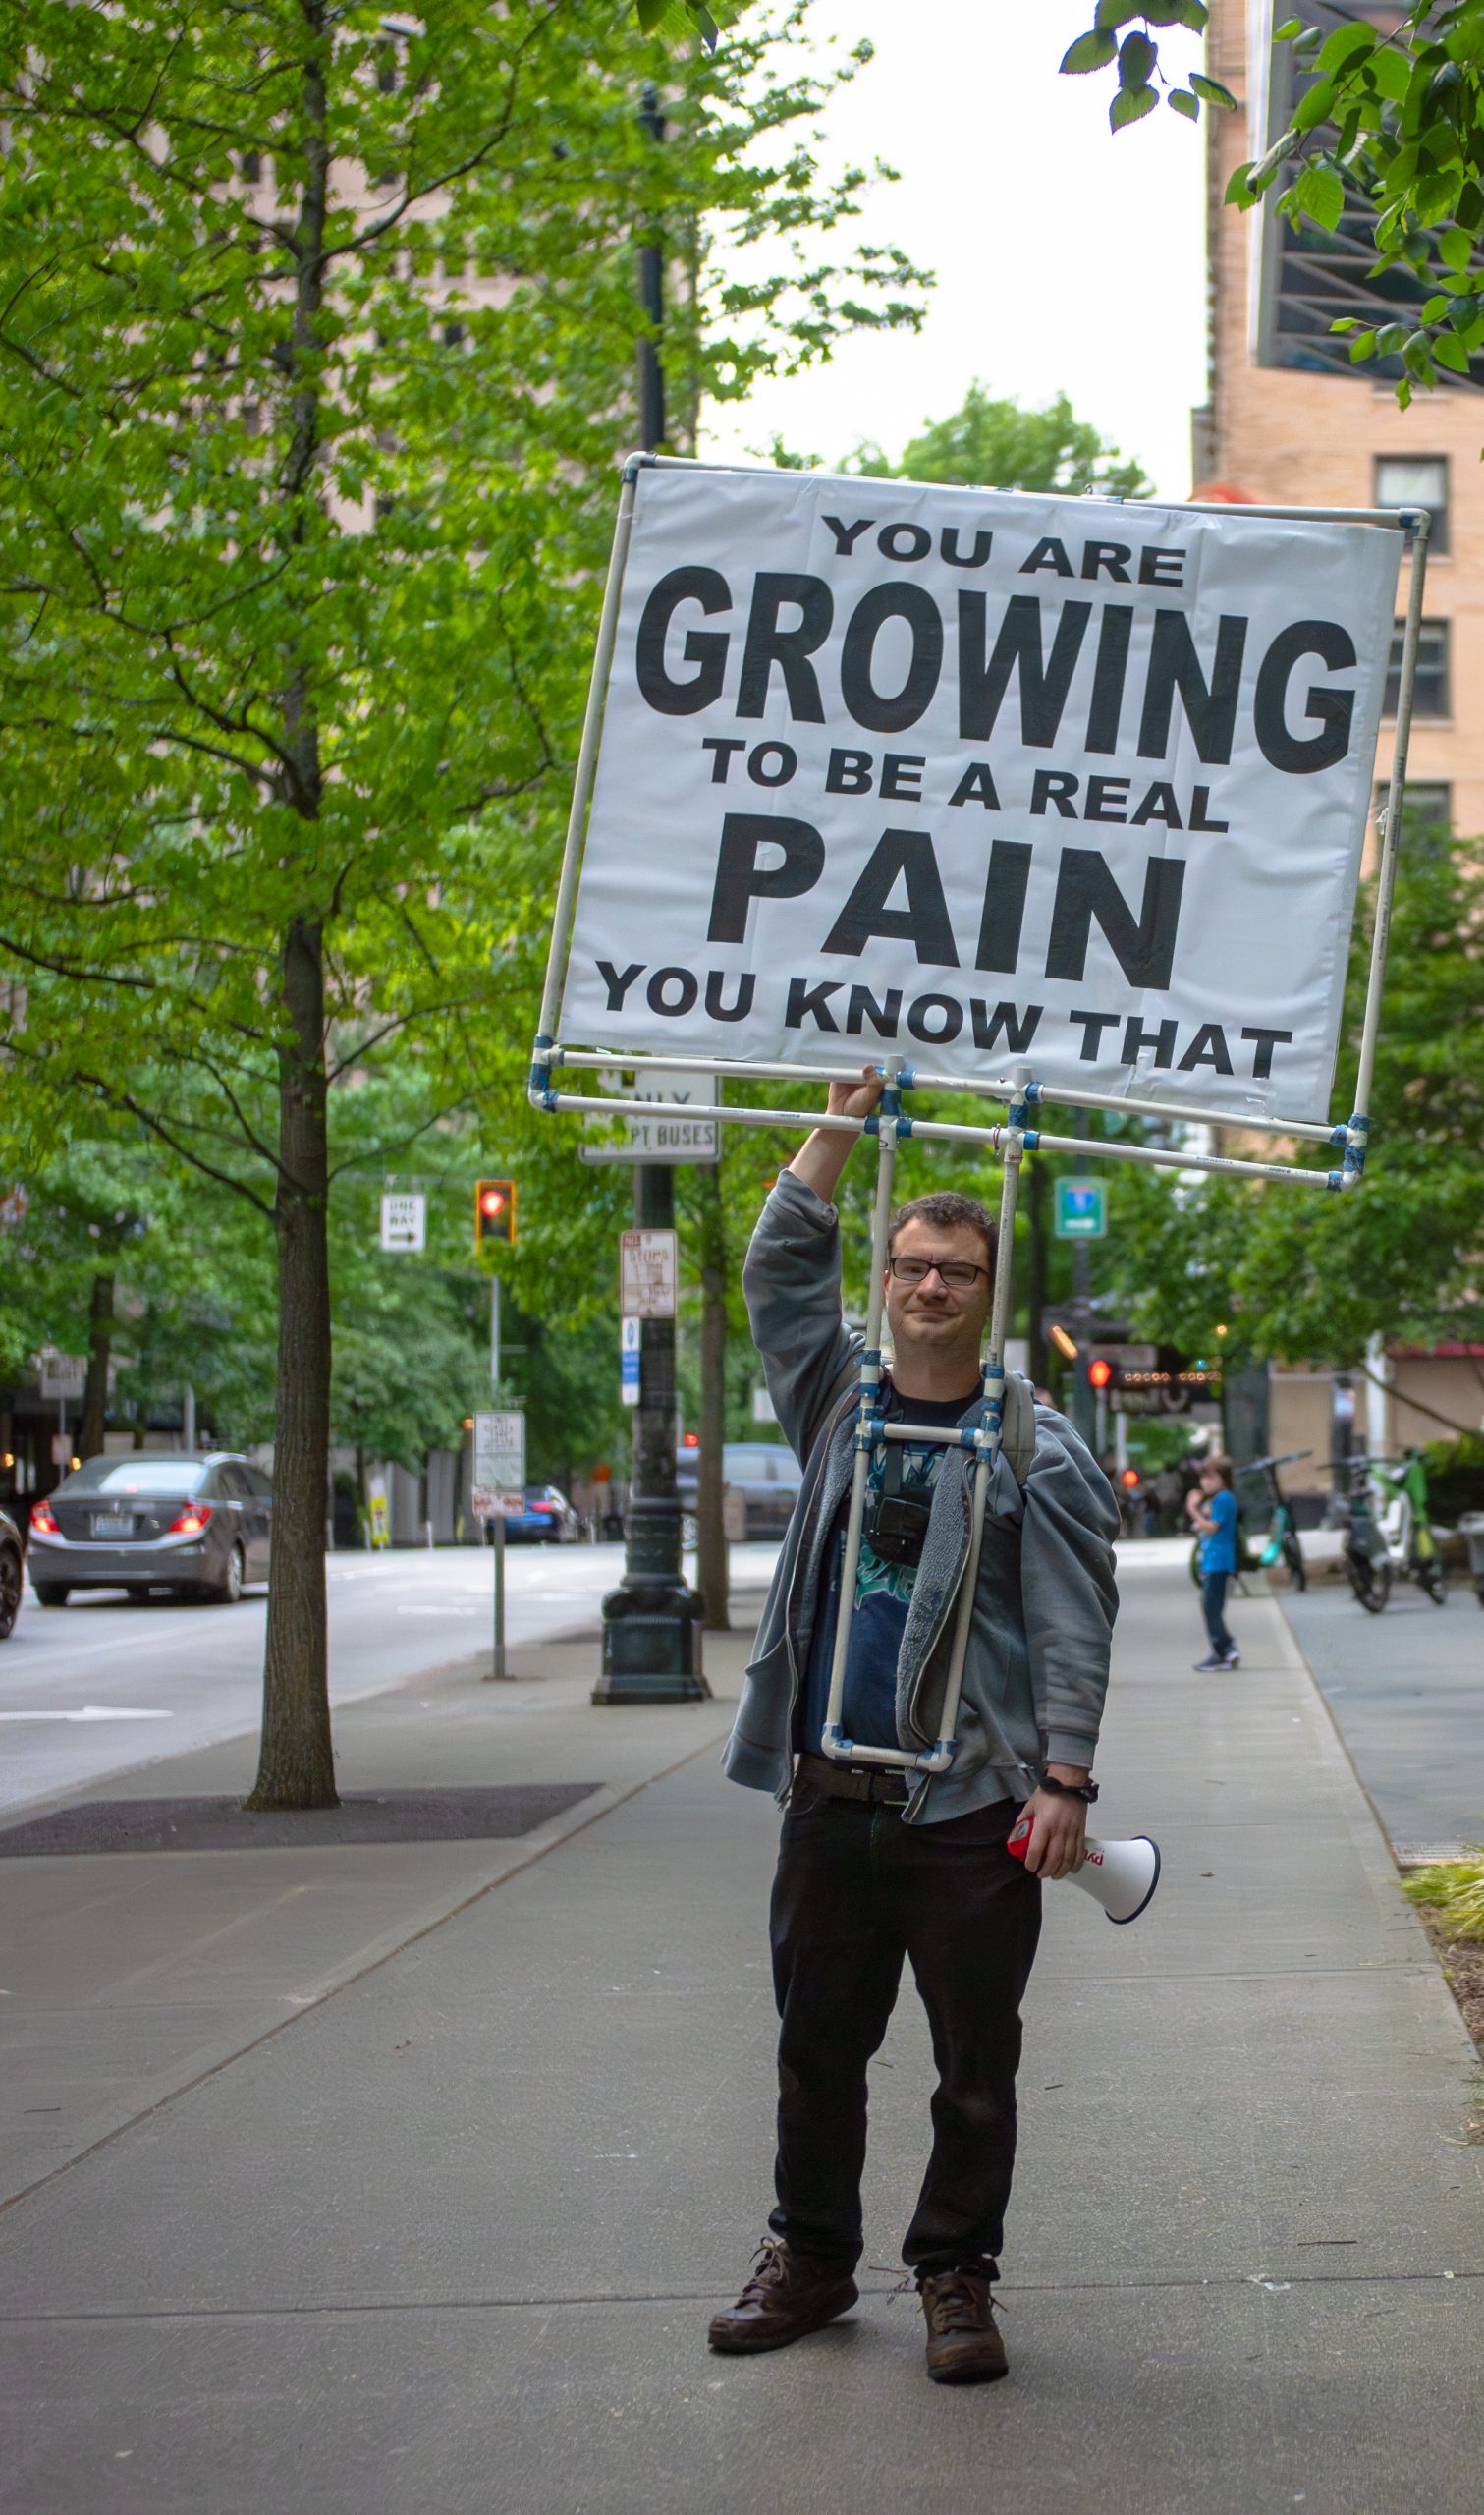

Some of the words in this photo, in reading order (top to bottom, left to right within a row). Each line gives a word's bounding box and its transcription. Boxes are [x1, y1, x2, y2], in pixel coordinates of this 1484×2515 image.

[821, 515, 993, 569] YOU
[1017, 536, 1187, 588] ARE
[634, 565, 1357, 776] GROWING
[701, 737, 797, 788] TO
[824, 748, 927, 803] BE
[947, 762, 1002, 811] A
[1028, 769, 1231, 834] REAL
[705, 811, 1187, 992] PAIN
[594, 960, 757, 1023] YOU
[783, 978, 1045, 1054] KNOW
[1068, 1009, 1294, 1081] THAT
[657, 1124, 715, 1146] BUSES
